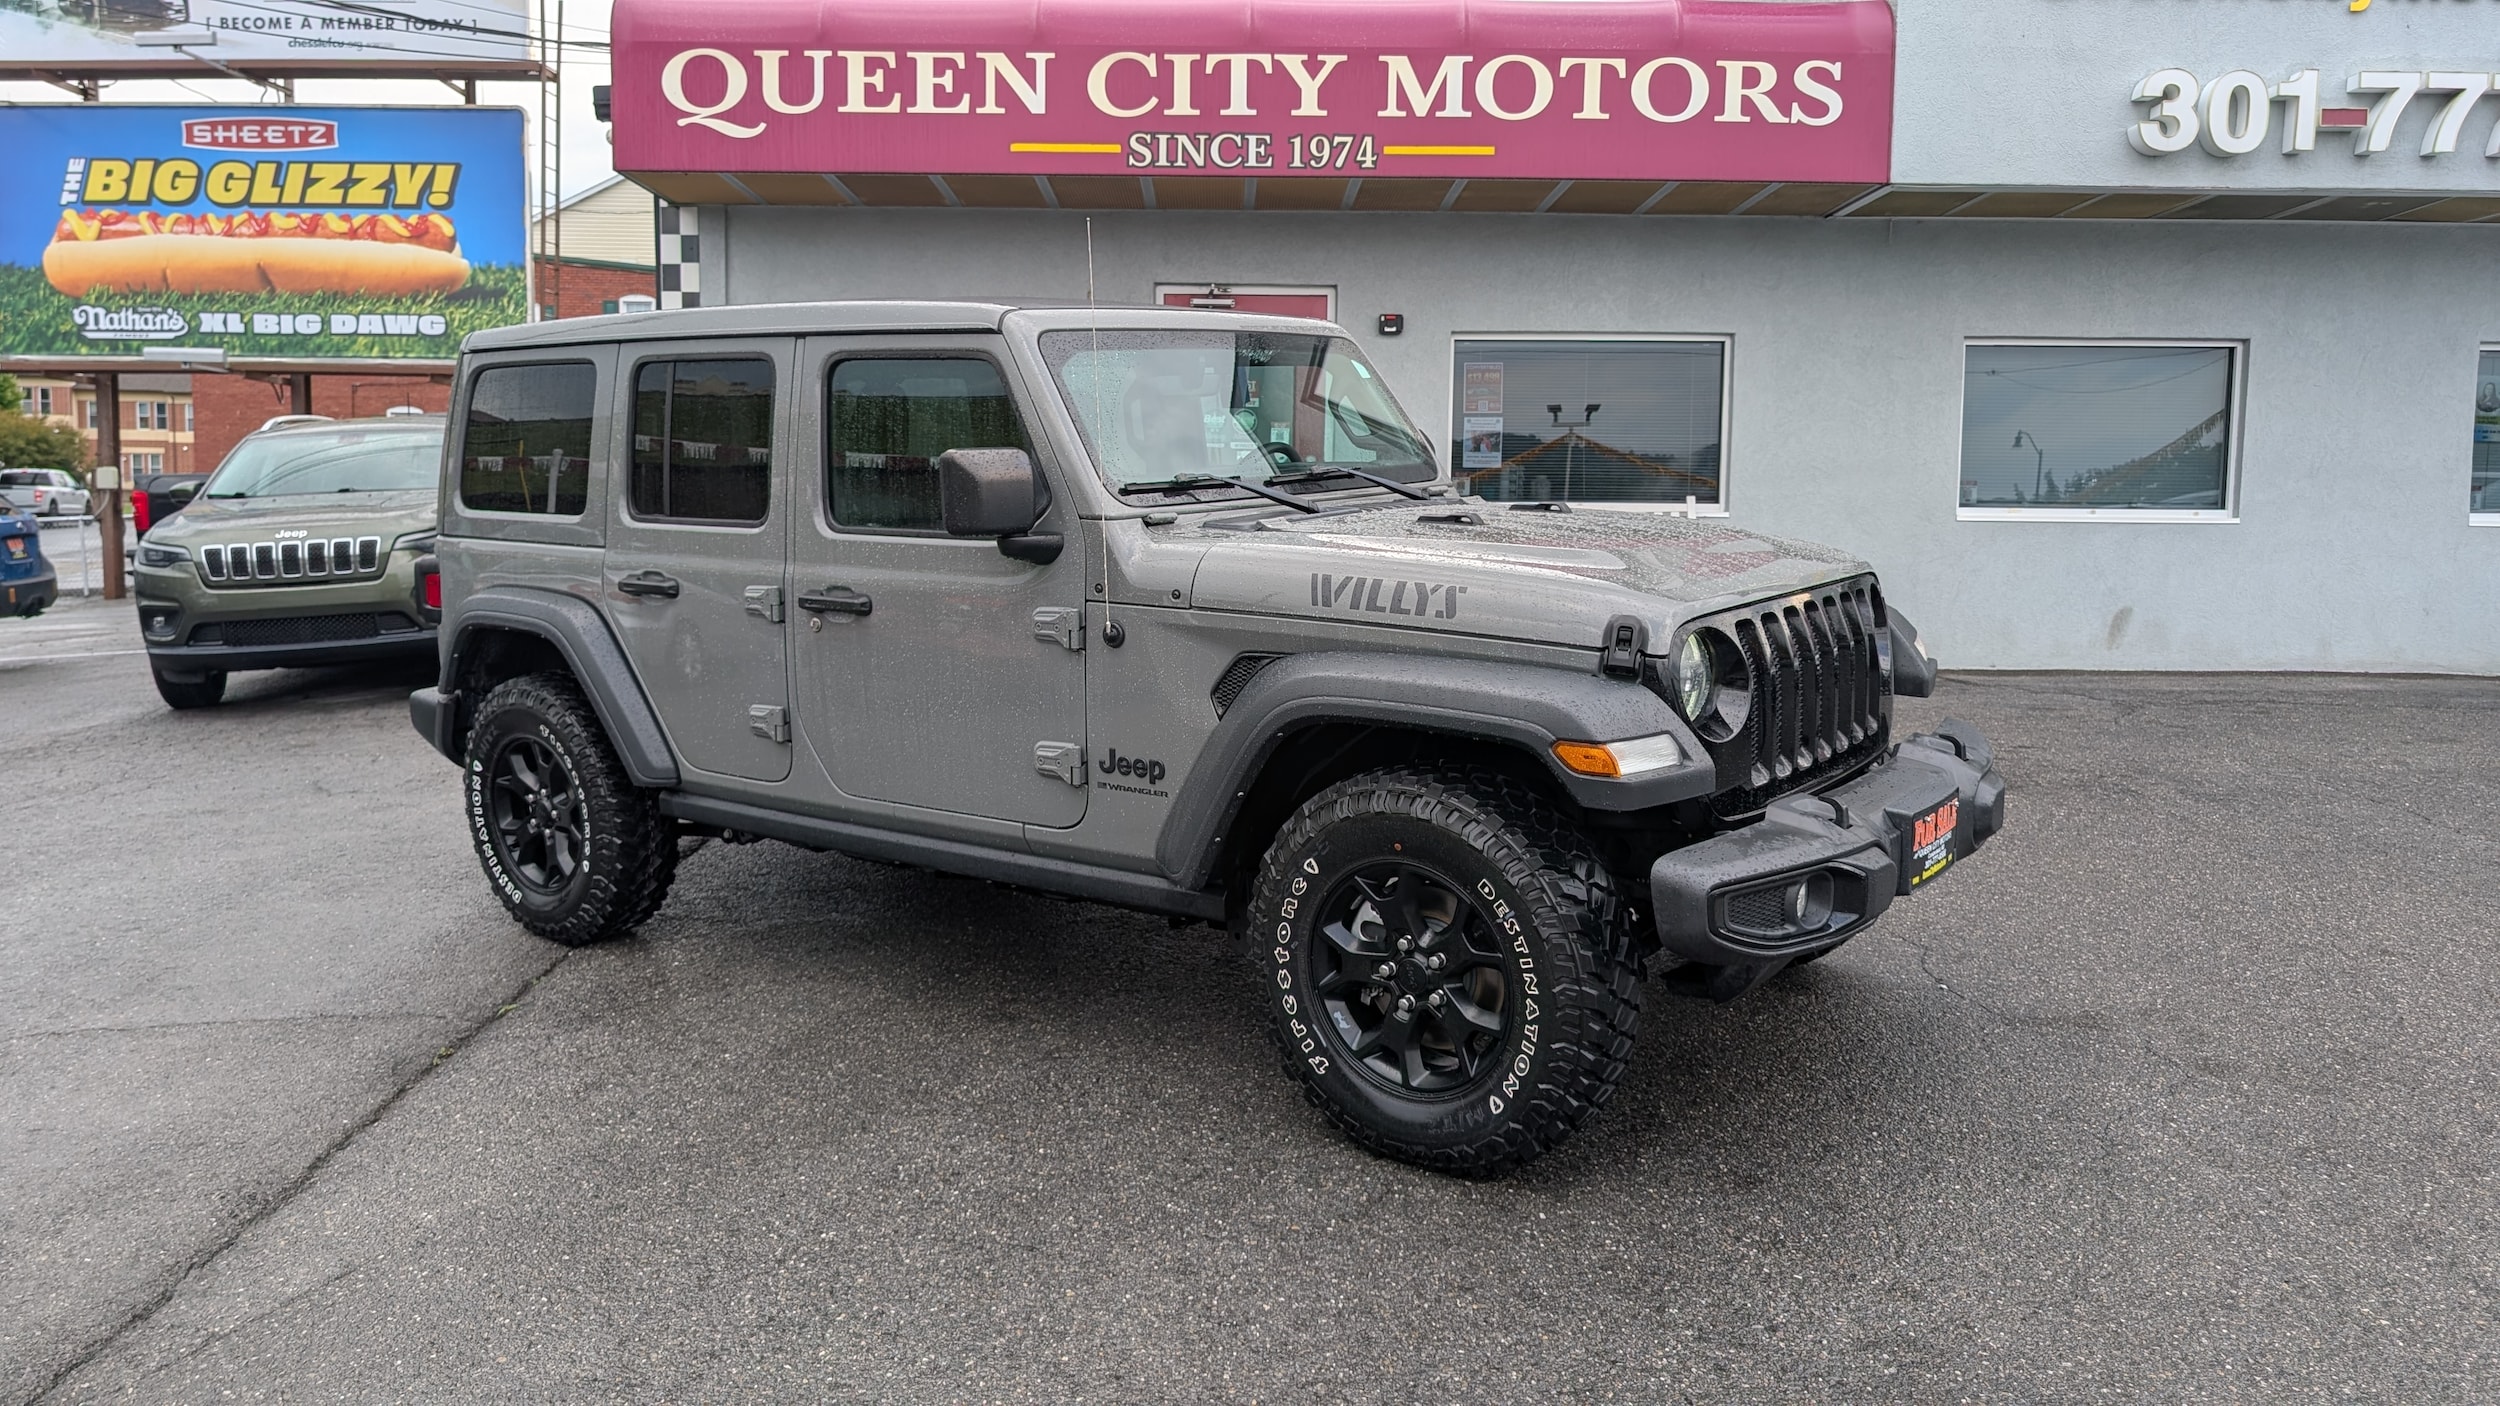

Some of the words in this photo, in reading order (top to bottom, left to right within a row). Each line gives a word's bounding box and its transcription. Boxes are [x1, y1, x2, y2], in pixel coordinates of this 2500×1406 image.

[220, 17, 292, 30] BECOME
[300, 17, 312, 30] A
[320, 17, 394, 31] MEMBER
[404, 18, 463, 32] TODAY
[660, 48, 1056, 139] QUEEN
[1086, 52, 1347, 118] CITY
[1377, 54, 1844, 126] MOTORS
[2127, 67, 2500, 158] 301-77
[192, 124, 328, 144] SHEETZ
[1126, 132, 1273, 169] SINCE
[1287, 133, 1378, 170] 1974
[59, 157, 87, 206] THE
[83, 158, 201, 206] BIG
[205, 160, 460, 208] GLIZZY!
[72, 304, 189, 333] Nathan's
[198, 313, 245, 334] XL
[253, 314, 323, 336] BIG
[330, 314, 447, 336] DAWG
[275, 530, 308, 539] Jeep
[1311, 572, 1468, 620] WILLYS
[1098, 747, 1166, 785] Jeep
[1107, 782, 1169, 798] WRANGLER
[1477, 878, 1540, 1099] DESTINATION
